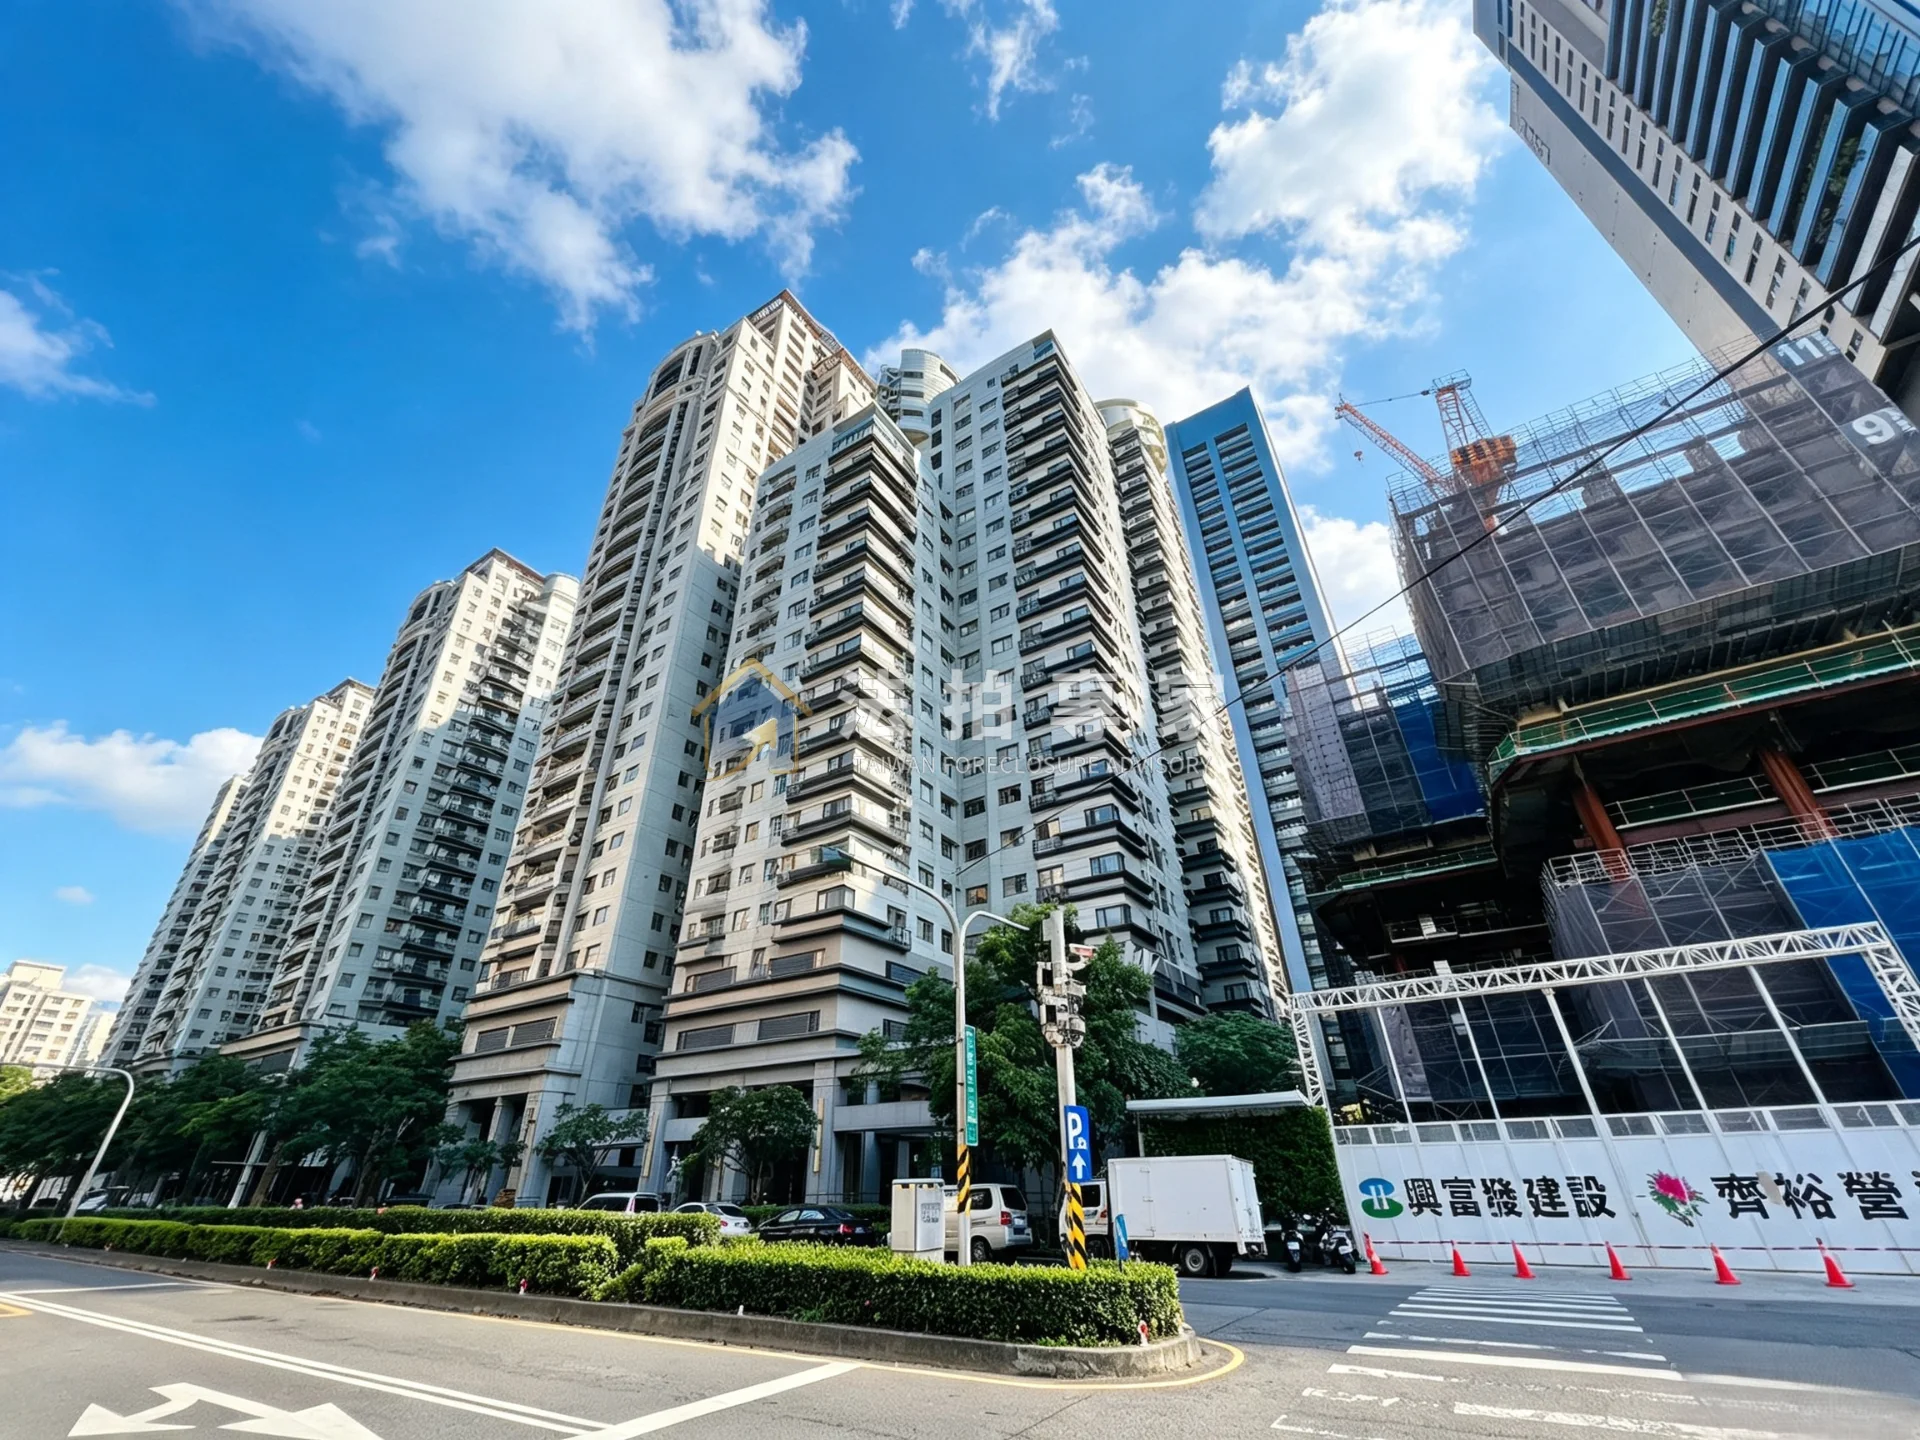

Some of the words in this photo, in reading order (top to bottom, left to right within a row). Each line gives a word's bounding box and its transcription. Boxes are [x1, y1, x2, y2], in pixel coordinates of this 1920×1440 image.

[1403, 1176, 1617, 1219] 興富發建設
[1710, 1171, 1920, 1220] 齊裕營
